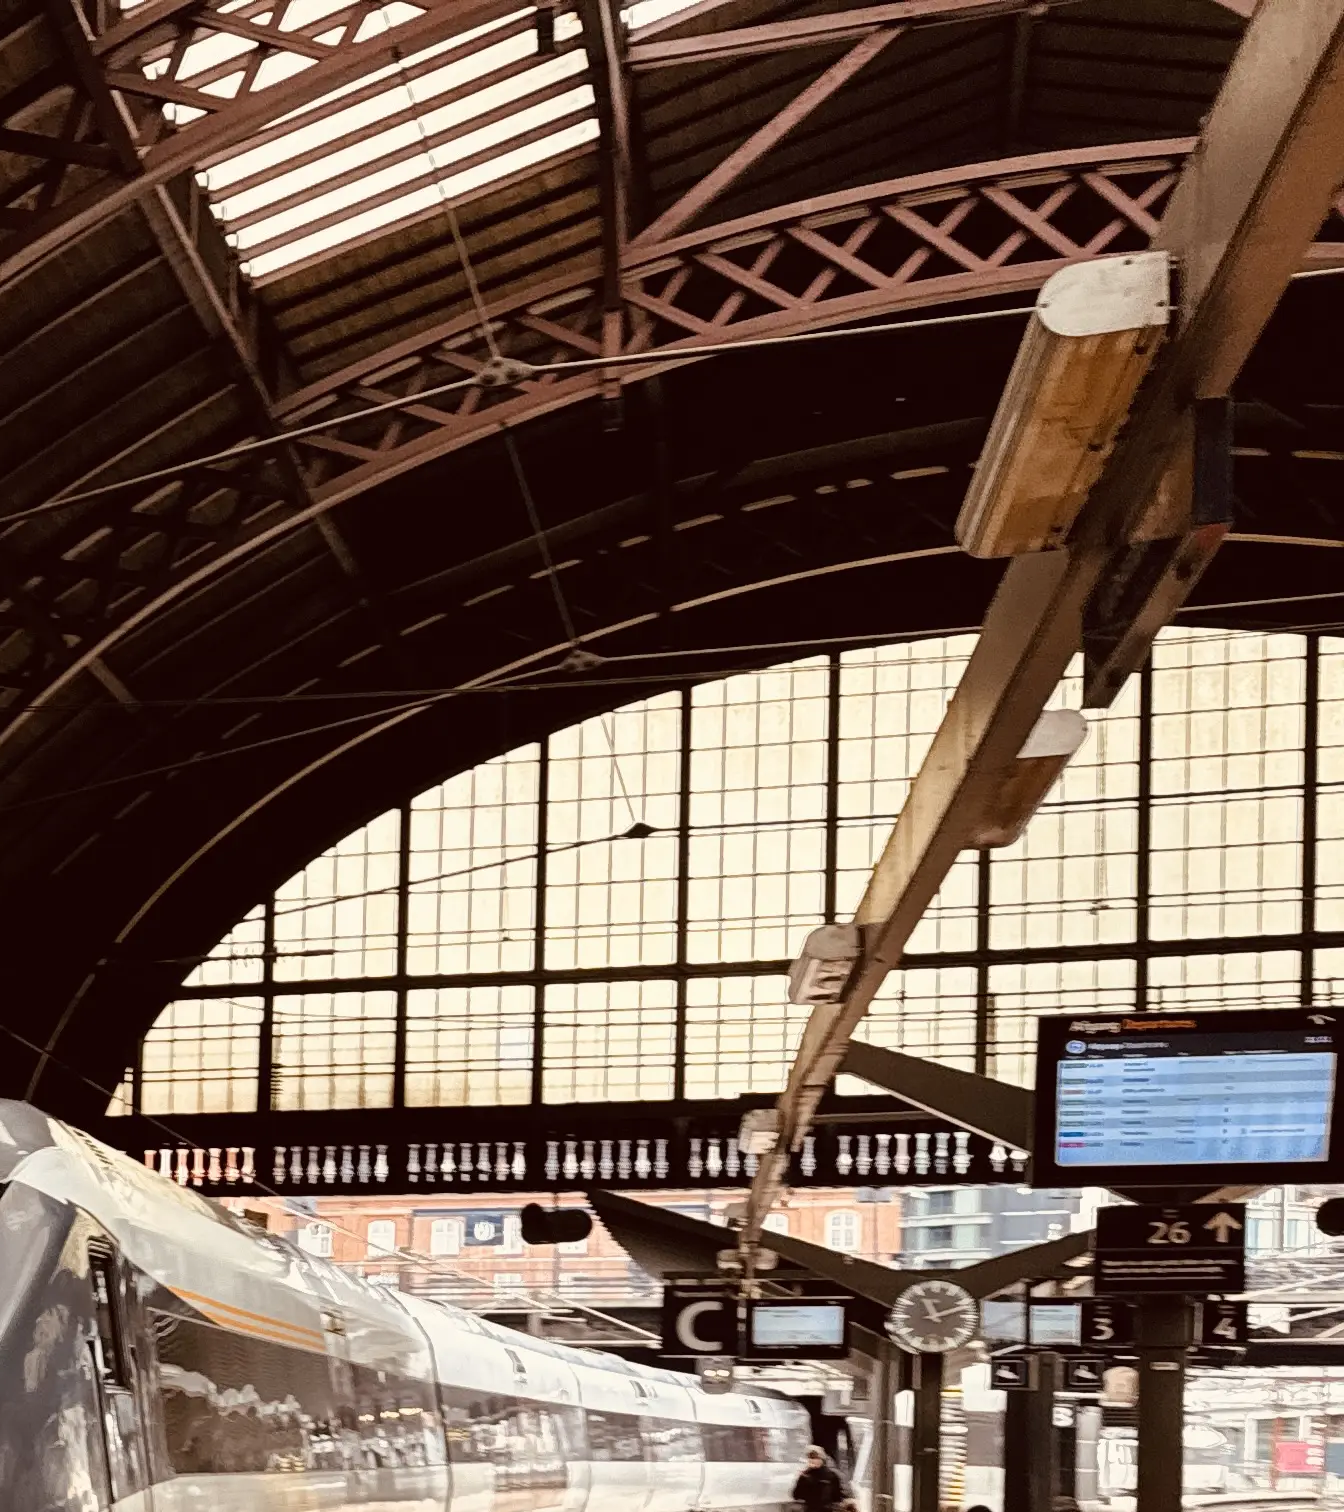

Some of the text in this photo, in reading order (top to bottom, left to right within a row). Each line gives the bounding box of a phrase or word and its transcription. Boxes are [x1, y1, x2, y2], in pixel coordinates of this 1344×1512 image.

[1146, 1221, 1192, 1244] 26
[675, 1300, 724, 1352] C
[1091, 1317, 1115, 1341] 3
[1212, 1317, 1237, 1341] 4
